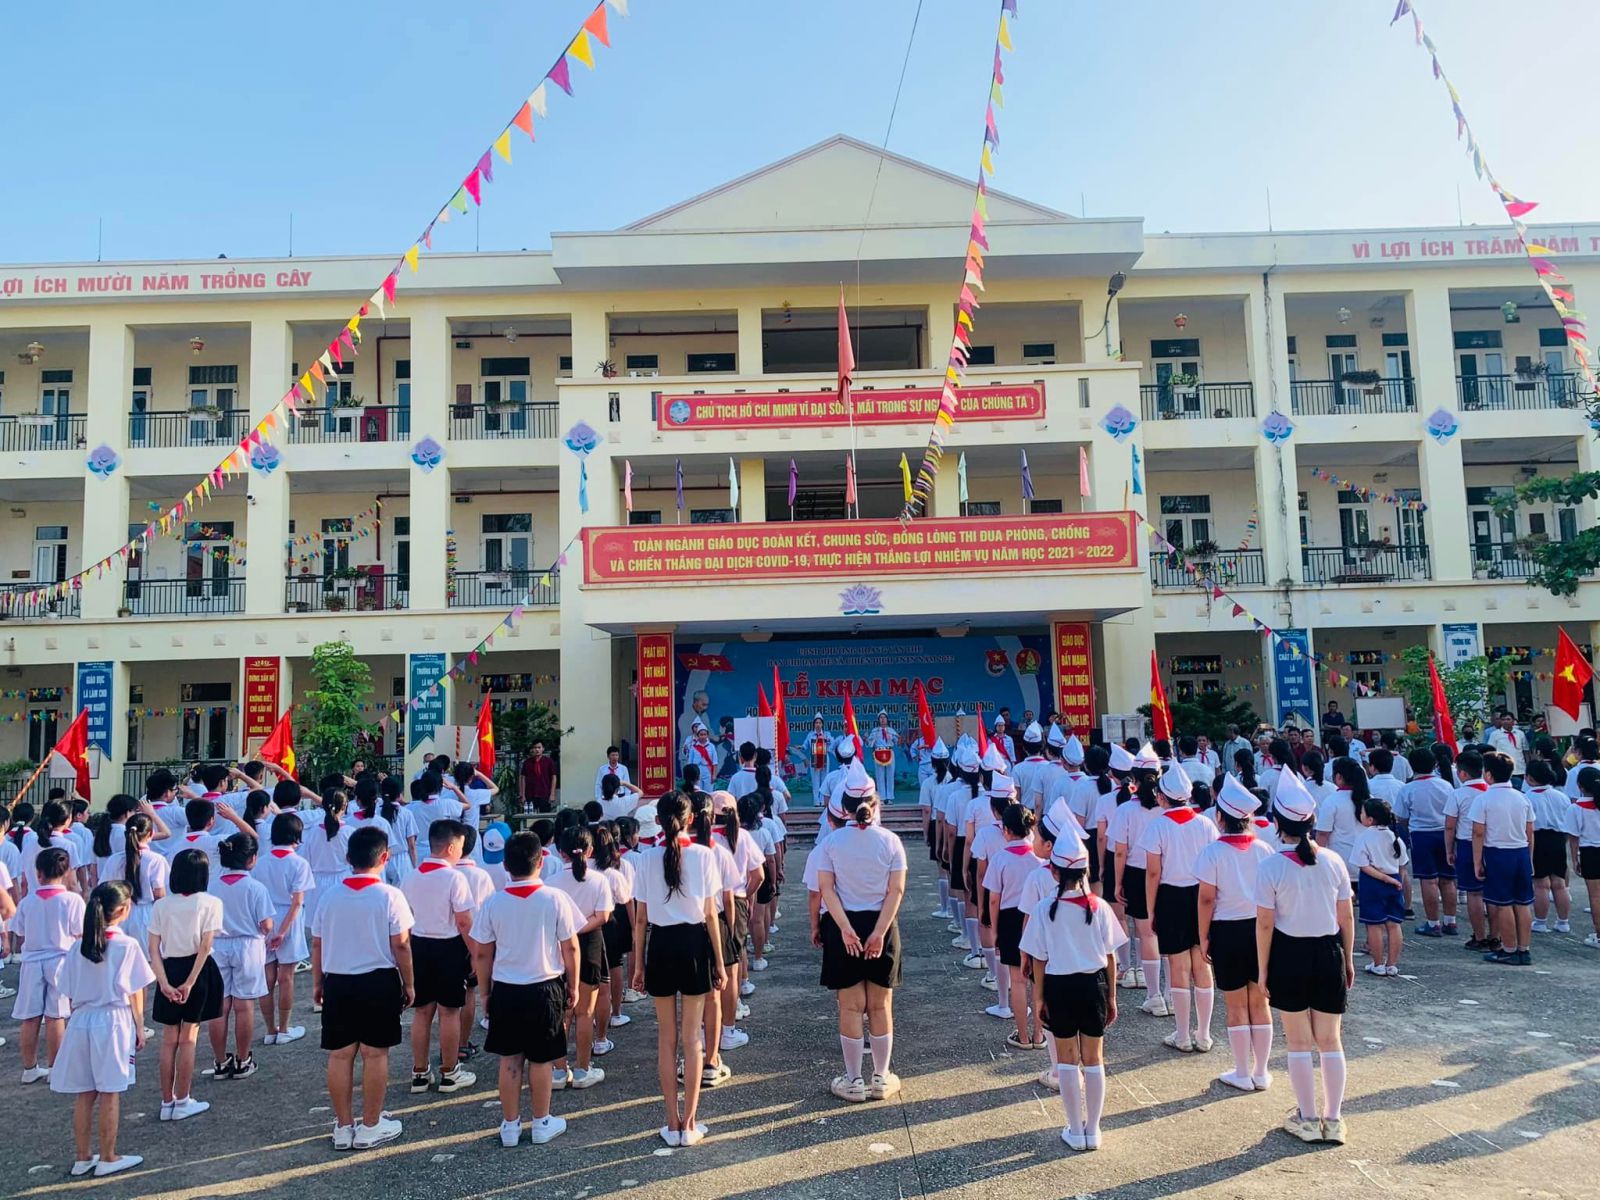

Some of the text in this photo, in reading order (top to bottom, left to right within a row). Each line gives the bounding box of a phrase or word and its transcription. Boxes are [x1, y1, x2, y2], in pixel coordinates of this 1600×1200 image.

[1352, 240, 1370, 258] VÌ
[1381, 242, 1411, 260] LỢI
[1421, 238, 1454, 256] ÍCH
[1465, 235, 1522, 255] TRĂM
[0, 267, 312, 297] ỢI ÍCH MƯỜI NĂM TRỒNG CÂY
[696, 401, 714, 418] CHỦ
[717, 404, 737, 421] TỊCH
[755, 401, 770, 417] CHÍ
[773, 403, 797, 417] MINH
[800, 400, 809, 416] VĨ
[811, 402, 826, 418] ĐẠI
[857, 398, 875, 414] MÃI
[877, 401, 907, 414] TRONG
[909, 398, 923, 415] SỰ
[960, 393, 980, 411] CỦA
[982, 395, 1013, 410] CHÚNG
[1016, 396, 1028, 409] TA
[633, 523, 1090, 552] TOÀN NGÀNH GIÁO DỤC ĐOÀN KẾT, CHUNG SỨC, ĐỒNG LÒNG THI ĐUA PHÒNG, CHỐNG
[610, 555, 625, 572] VÀ
[628, 554, 662, 571] CHIẾN
[665, 554, 702, 570] THẮNG
[705, 557, 723, 572] ĐẠI
[727, 556, 753, 571] DỊCH
[813, 553, 841, 568] THỰC
[845, 550, 871, 568] HIỆN
[875, 548, 911, 564] THẮNG
[914, 550, 931, 566] LỢI
[935, 548, 971, 565] NHIỆM
[975, 549, 989, 563] VỤ
[993, 547, 1019, 560] NĂM
[1022, 548, 1045, 562] HỌC
[1048, 546, 1075, 559] 2021
[1086, 545, 1114, 558] 2022
[1062, 633, 1085, 648] GIÁO DỤC
[643, 646, 656, 658] PHÁT
[781, 672, 944, 699] LỄ KHAI MẠC
[1061, 672, 1074, 686] PHÁT
[644, 725, 668, 740] SÁNG TẠO
[645, 743, 656, 758] CỦA
[645, 765, 653, 779] CÁ
